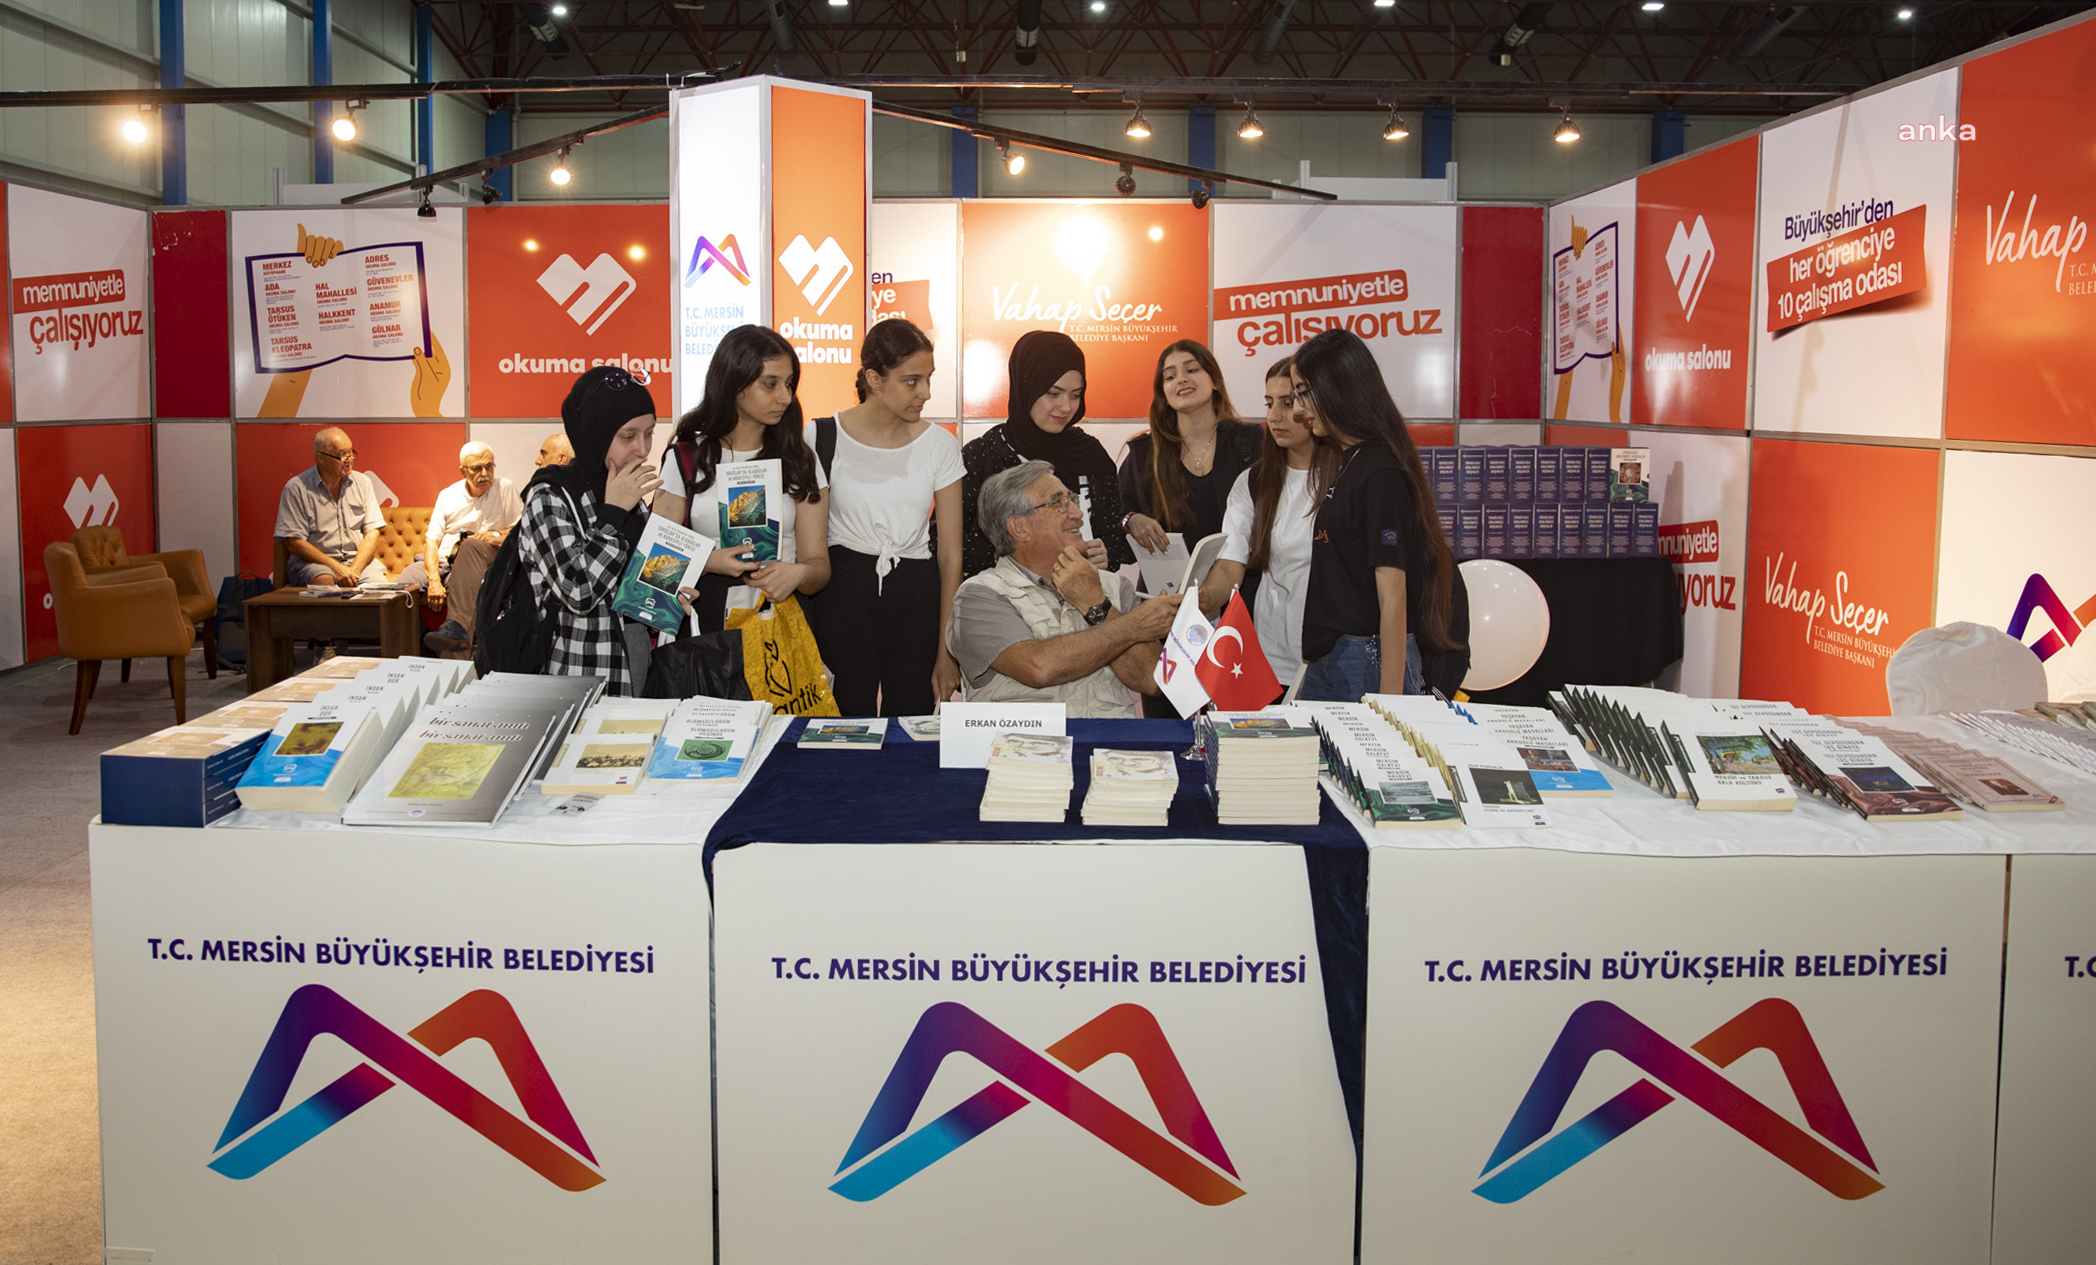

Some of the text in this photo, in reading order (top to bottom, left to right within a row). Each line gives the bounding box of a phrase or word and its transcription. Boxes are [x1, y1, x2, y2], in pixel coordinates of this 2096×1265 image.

[1784, 199, 1894, 241] Büyükşehir'den
[1986, 190, 2087, 293] Vahap
[262, 261, 292, 270] MERKEZ
[365, 254, 389, 263] ADRES
[1789, 225, 1896, 284] her öğrenciye
[367, 274, 414, 286] GÜVENEVLER
[2069, 262, 2089, 277] T.C.
[23, 274, 124, 305] memnuniyetle
[265, 283, 280, 291] ADA
[316, 286, 357, 299] MAHALLESİ
[1229, 275, 1404, 312] memnuniyetle
[1777, 260, 1903, 321] 10 çalışma odası
[2069, 280, 2096, 295] BELE
[267, 305, 295, 314] TARSUS
[318, 309, 356, 319] HALKKENT
[704, 303, 744, 319] MERSİN
[992, 281, 1163, 332] Vahap Seçer
[29, 309, 144, 355] çalışıyoruz
[372, 324, 401, 334] GÜLNAR
[780, 317, 853, 340] okuma
[1072, 334, 1148, 343] BELEDİYE BAŞKANI
[1087, 324, 1120, 332] MERSİN
[1123, 324, 1178, 334] BÜYÜKŞEHİR
[270, 336, 298, 345] TARSUS
[499, 353, 586, 374] okuma
[797, 341, 852, 364] alonu
[1645, 344, 1731, 372] okuma salonu
[1658, 526, 1717, 560] mnuniyetle
[1765, 552, 1889, 644] Vahap Seçer
[1814, 639, 1874, 668] BELEDİYE BAŞKANI
[1826, 630, 1853, 646] MERSİN
[1854, 637, 1896, 659] BÜYÜKŞEHİ
[965, 718, 1042, 728] ERKAN ÖZAYDIN
[148, 936, 653, 973] T.C. MERSİN BÜYÜKŞEHİR BELEDİYESİ
[1425, 947, 1947, 985] T.C. MERSİN BÜYÜKŞEHİR BELEDİYESİ
[772, 953, 1305, 989] T.C. MERSİN BÜYÜKŞEHİR BELEDİYESİ
